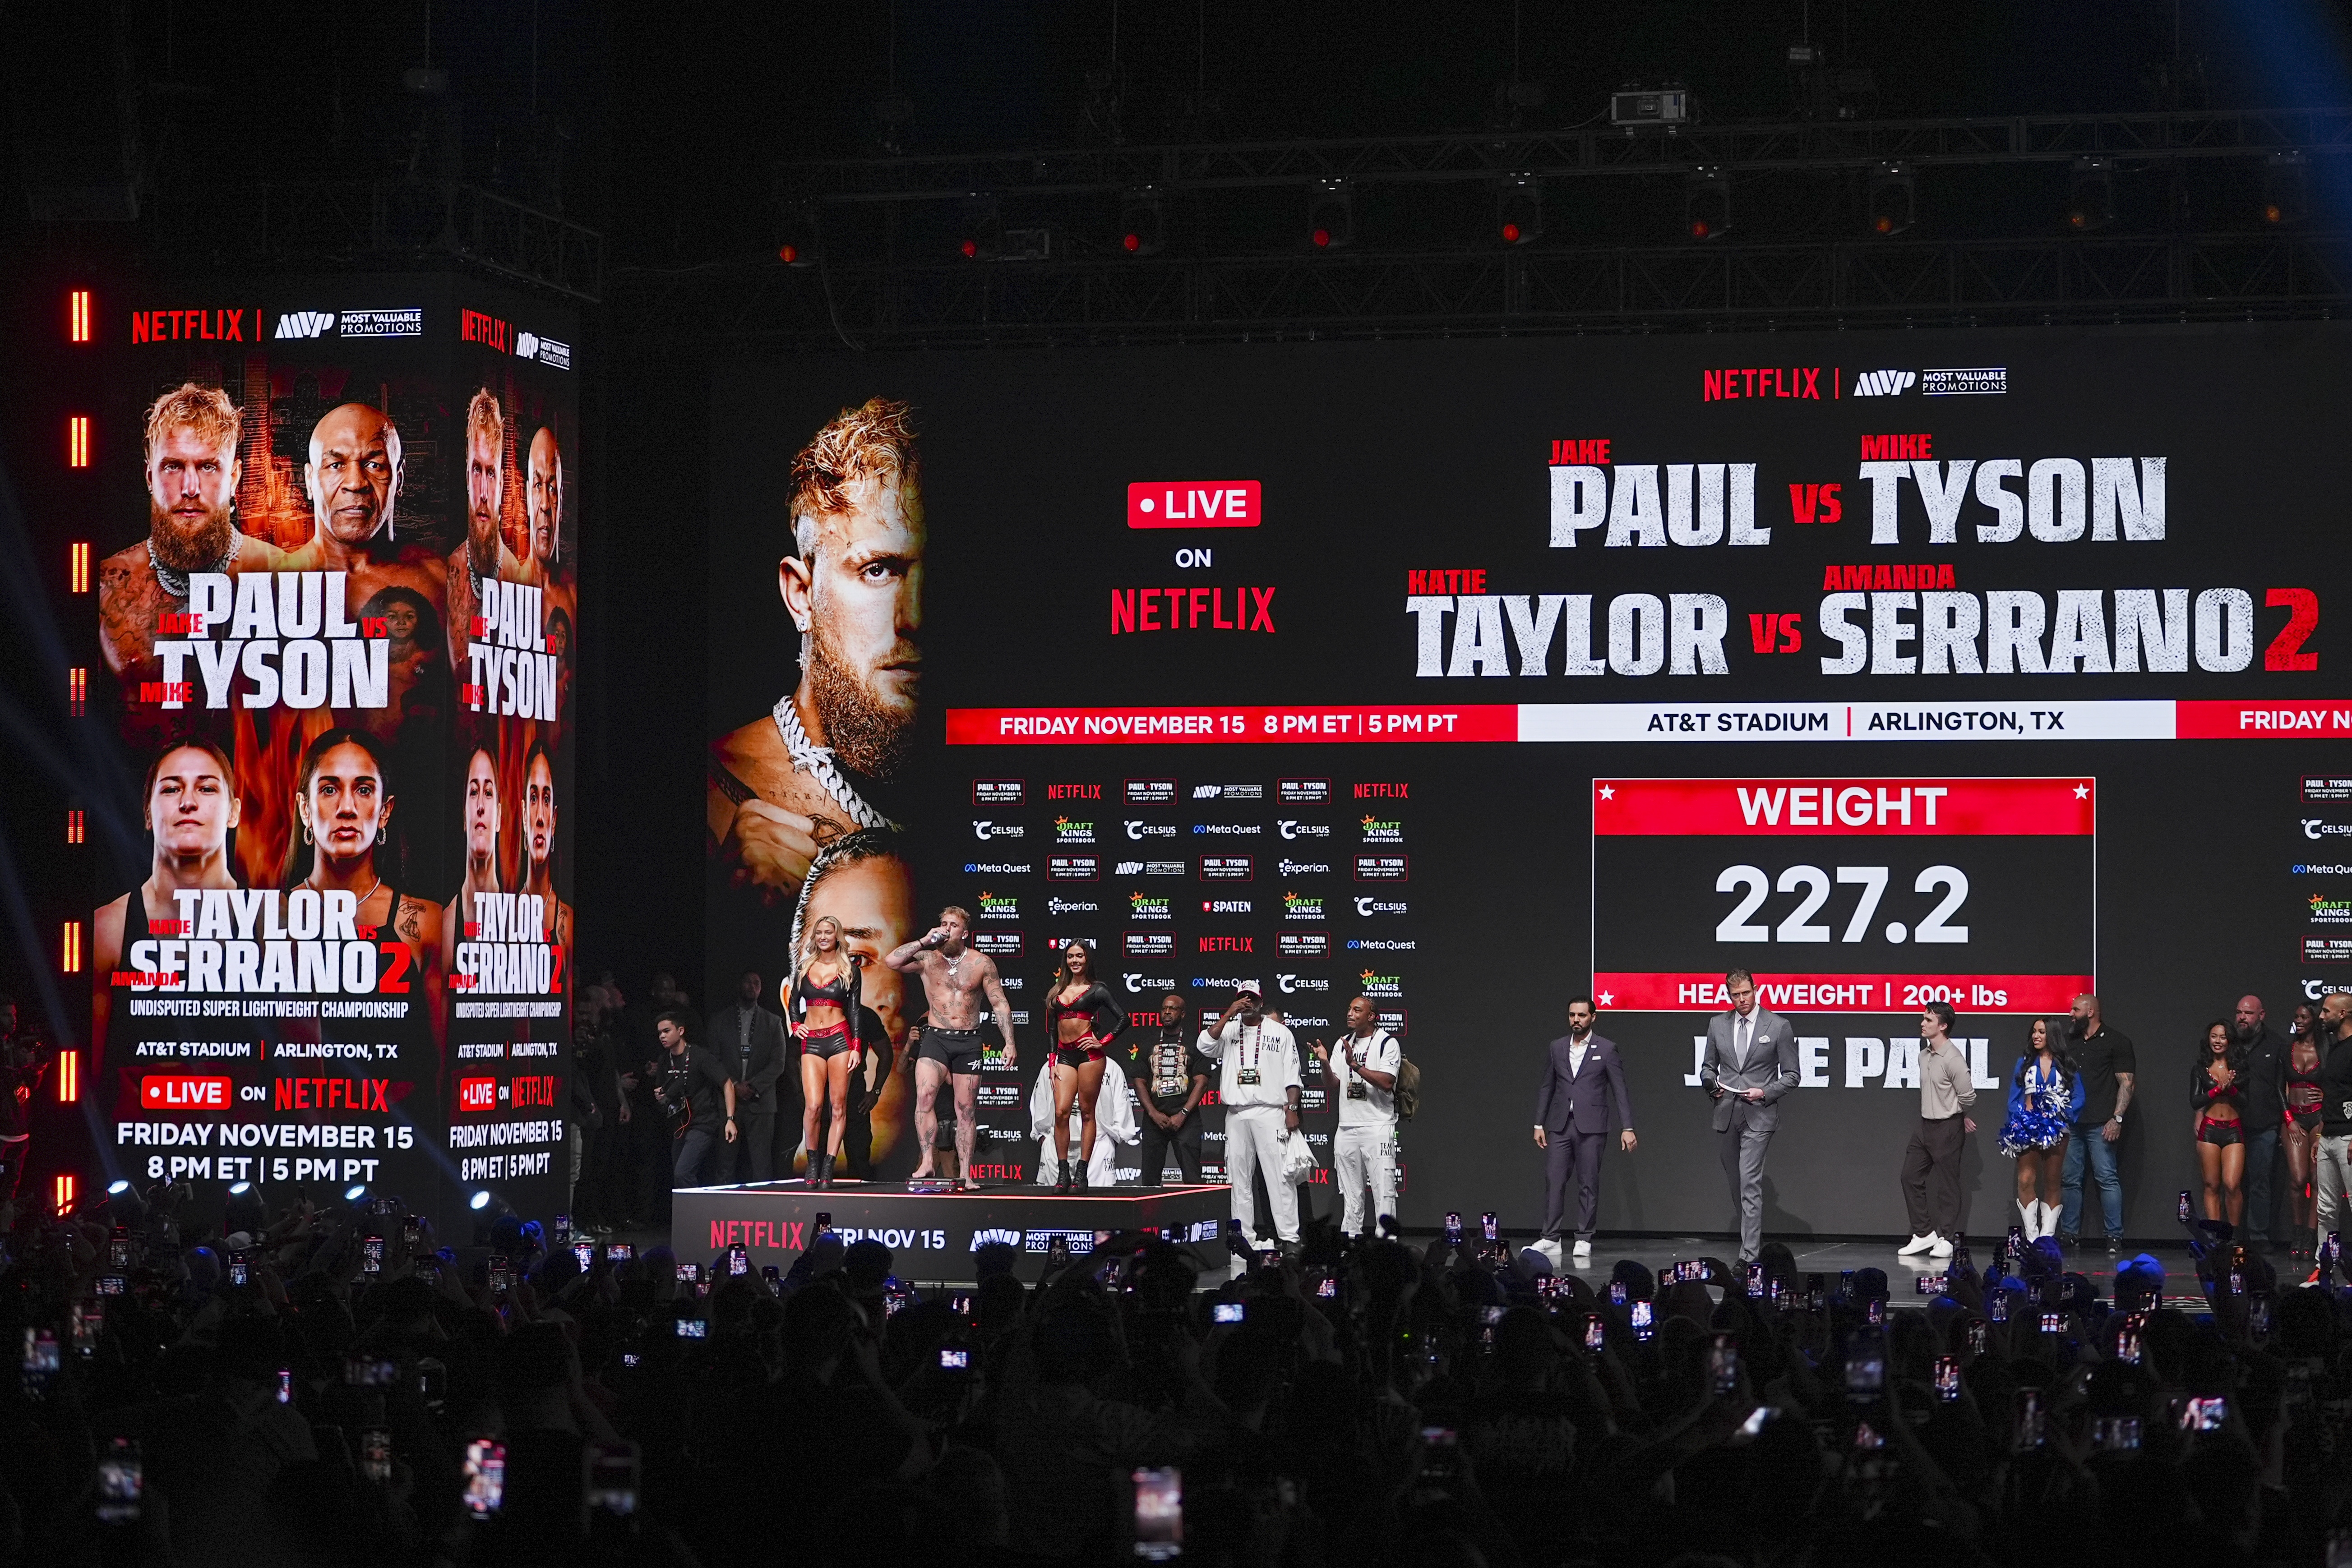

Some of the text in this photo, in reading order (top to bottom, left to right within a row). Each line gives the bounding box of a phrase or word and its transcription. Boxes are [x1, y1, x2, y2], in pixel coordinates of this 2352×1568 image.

[133, 309, 334, 344] NETFLIX MVP
[341, 313, 421, 323] MOST VALUABLE
[341, 323, 421, 333] PROMOTIONS
[462, 309, 505, 352] NETFLIX
[540, 350, 569, 367] PROMOTIONS
[541, 341, 569, 357] MOST VALUABLE
[1705, 368, 1916, 401] NETFLIX MVP
[1922, 381, 2007, 391] PROMOTIONS
[1923, 372, 2006, 382] MOST VALUABLE
[1549, 434, 1932, 465] JAKE MIKE
[1166, 490, 1246, 518] LIVE
[1549, 457, 2167, 547] PAUL VS TYSON
[1176, 549, 1211, 567] ON
[1409, 564, 1955, 594] KATIE AMANDA
[188, 571, 356, 639] PAUL
[481, 577, 545, 652] PAUL
[546, 634, 556, 654] VS
[1112, 587, 1275, 635] NETFLIX
[155, 613, 387, 637] JAKE VS
[1406, 588, 2319, 677] TAYLOR VS SERRANO 2
[153, 639, 389, 710] TYSON
[468, 642, 557, 722] TYSON
[140, 682, 193, 702] MIKE
[1001, 715, 1457, 734] FRIDAY NOVEMBER 15 8 PM ET 5 PM PT
[1648, 712, 2064, 734] AT&T STADIUM ARLINGTON, TX
[2241, 710, 2327, 729] FRIDAY
[1049, 785, 1101, 799] NETFLIX
[1354, 784, 1408, 798] NETFLIX
[1737, 787, 1947, 826] WEIGHT
[1057, 822, 1093, 831] DRAFT
[1142, 826, 1177, 835] CELSIUS
[1207, 825, 1261, 835] Meta Quest
[978, 864, 1030, 873] Meta Quest
[172, 889, 377, 940] TAYLOR VS
[1213, 901, 1251, 912] SPATEN
[1716, 865, 1968, 943] 227.2
[2310, 901, 2351, 910] DRAFT
[2315, 908, 2350, 916] KINGS
[149, 919, 190, 934] KATIE
[474, 892, 544, 943] TAYLOR
[1200, 937, 1252, 952] NETFLIX
[1361, 941, 1415, 950] Meta Quest
[130, 940, 410, 993] SERRANO 2
[456, 942, 562, 994] SERRANO 2
[111, 972, 180, 986] AMANDA
[1678, 983, 2007, 1006] HEAYWEIGHT 200+ lbs
[130, 1000, 408, 1018] UNDISPUTED SUPER LIGHTWEIGHT CHAMPIONSHIP
[456, 1002, 561, 1018] UNDISPUTED SUPER LIGHTWEIGHT CHAMPIONSHIP
[458, 1042, 557, 1058] AT&T STADIUM ARLINGTON, TX
[1262, 1042, 1280, 1052] PAUL
[1263, 1035, 1280, 1044] TEAM
[136, 1042, 397, 1061] AT&T STADIUM ARLINGTON, TX
[1683, 1036, 1999, 1089] JE PAL
[167, 1078, 388, 1112] LIVE ON NETFLIX
[470, 1076, 554, 1109] LIVE ON NETFLIX
[118, 1123, 413, 1148] FRIDAY NOVEMBER 15
[450, 1120, 562, 1148] FRIDAY NOVEMBER 15
[148, 1156, 379, 1181] 8 PM ET 5 PM PT
[462, 1152, 550, 1181] 8 PM ET 5 PM PT
[710, 1220, 945, 1251] NETFLIX NOV 15
[1026, 1233, 1050, 1241] MOST
